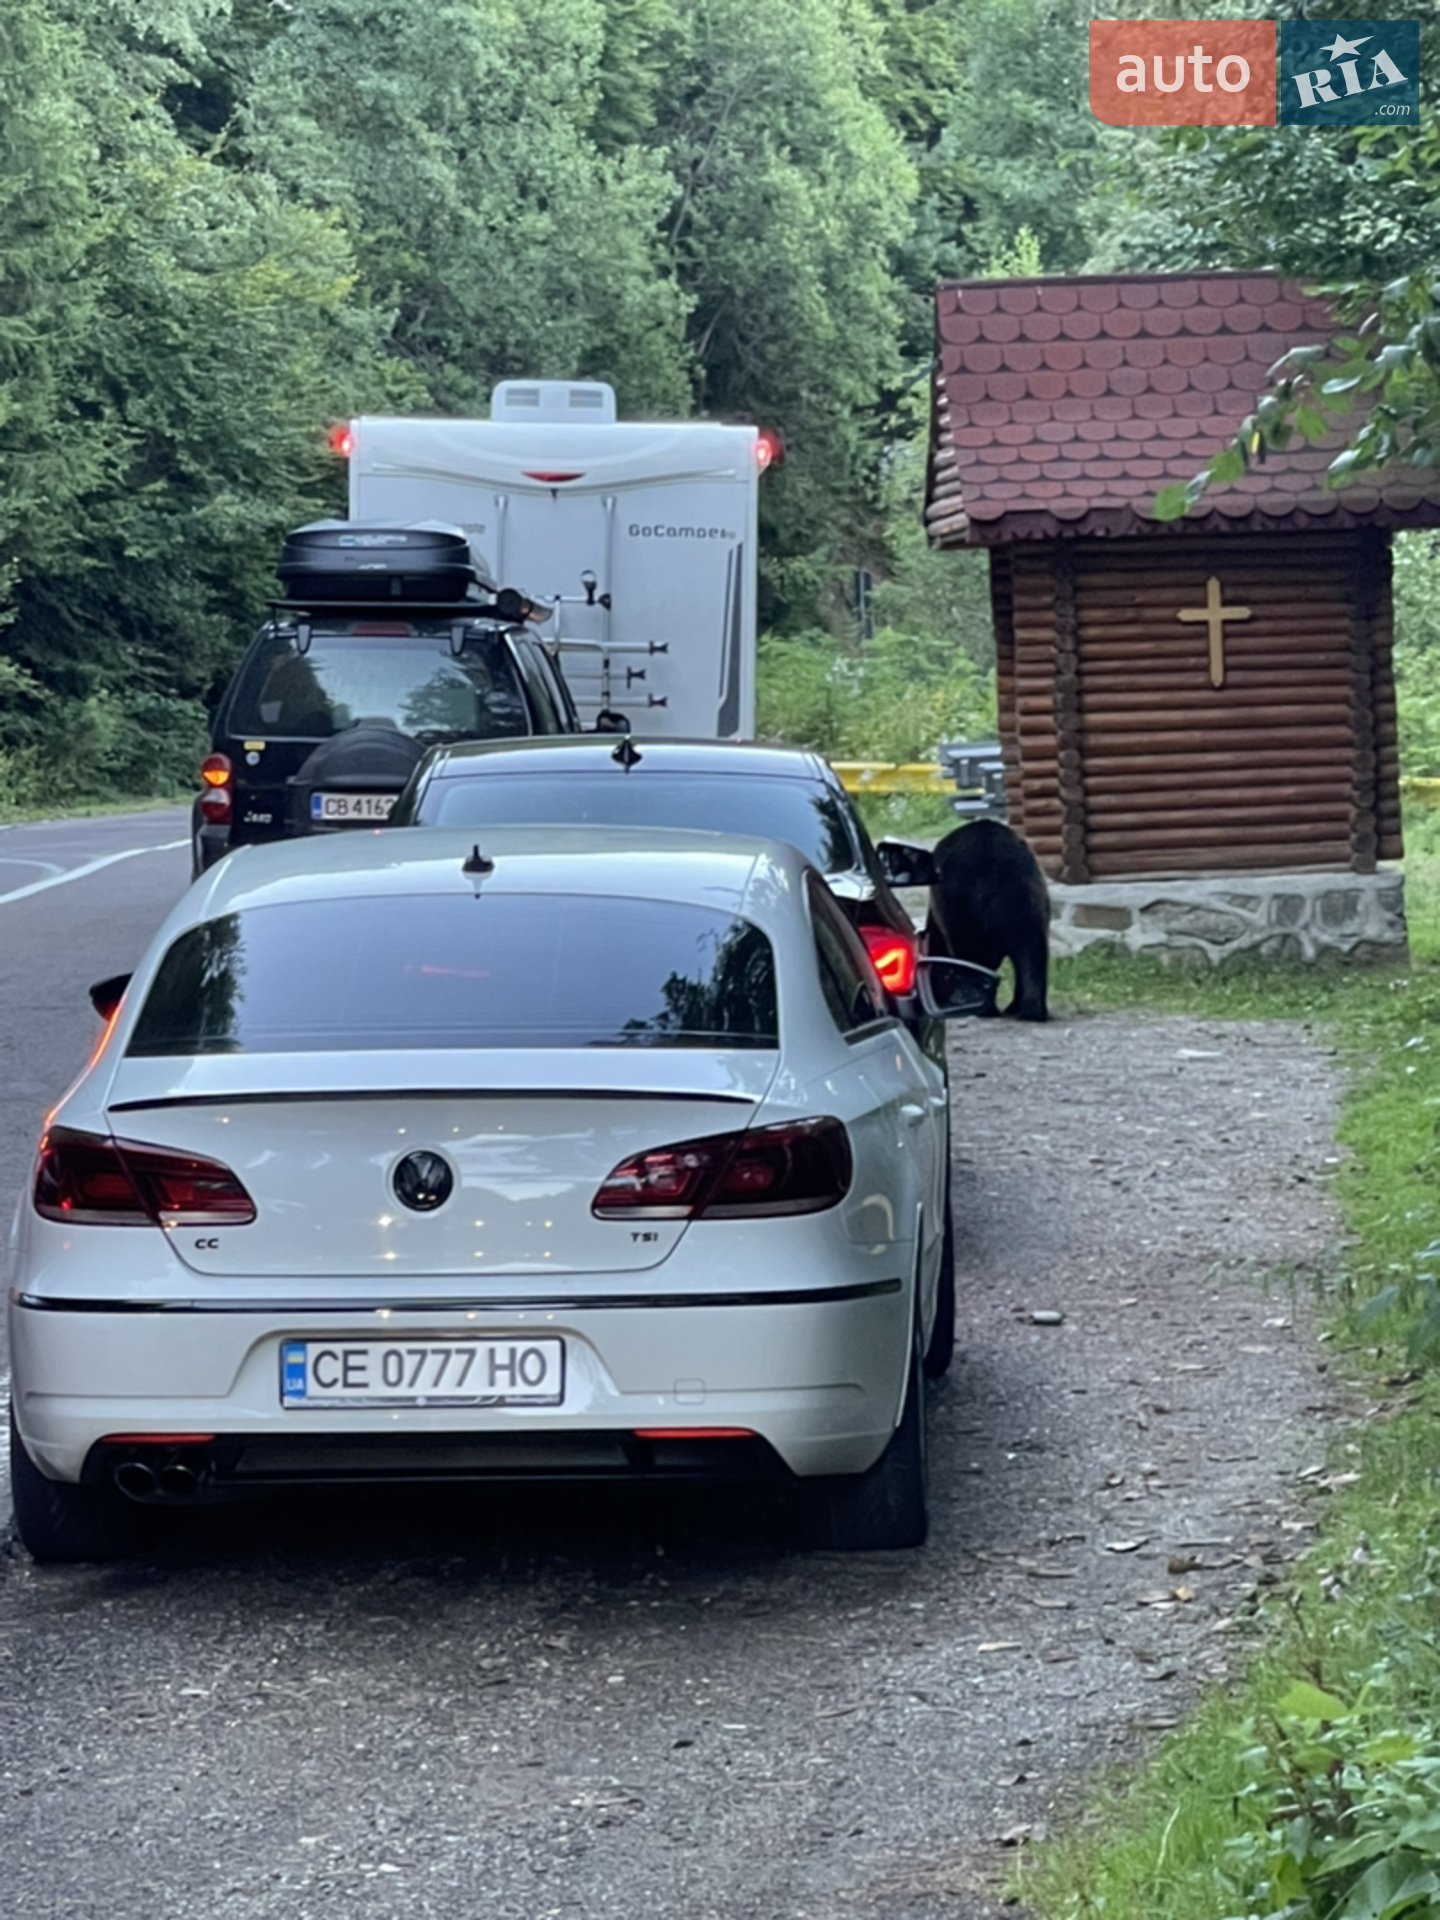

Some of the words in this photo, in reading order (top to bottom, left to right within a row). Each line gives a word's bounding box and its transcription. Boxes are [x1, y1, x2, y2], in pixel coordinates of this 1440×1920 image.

[325, 798, 348, 816] CB
[194, 1237, 220, 1250] CC
[630, 1231, 659, 1242] TSI
[312, 1349, 370, 1389] CE
[381, 1347, 477, 1388] 0777
[488, 1346, 548, 1387] HO
